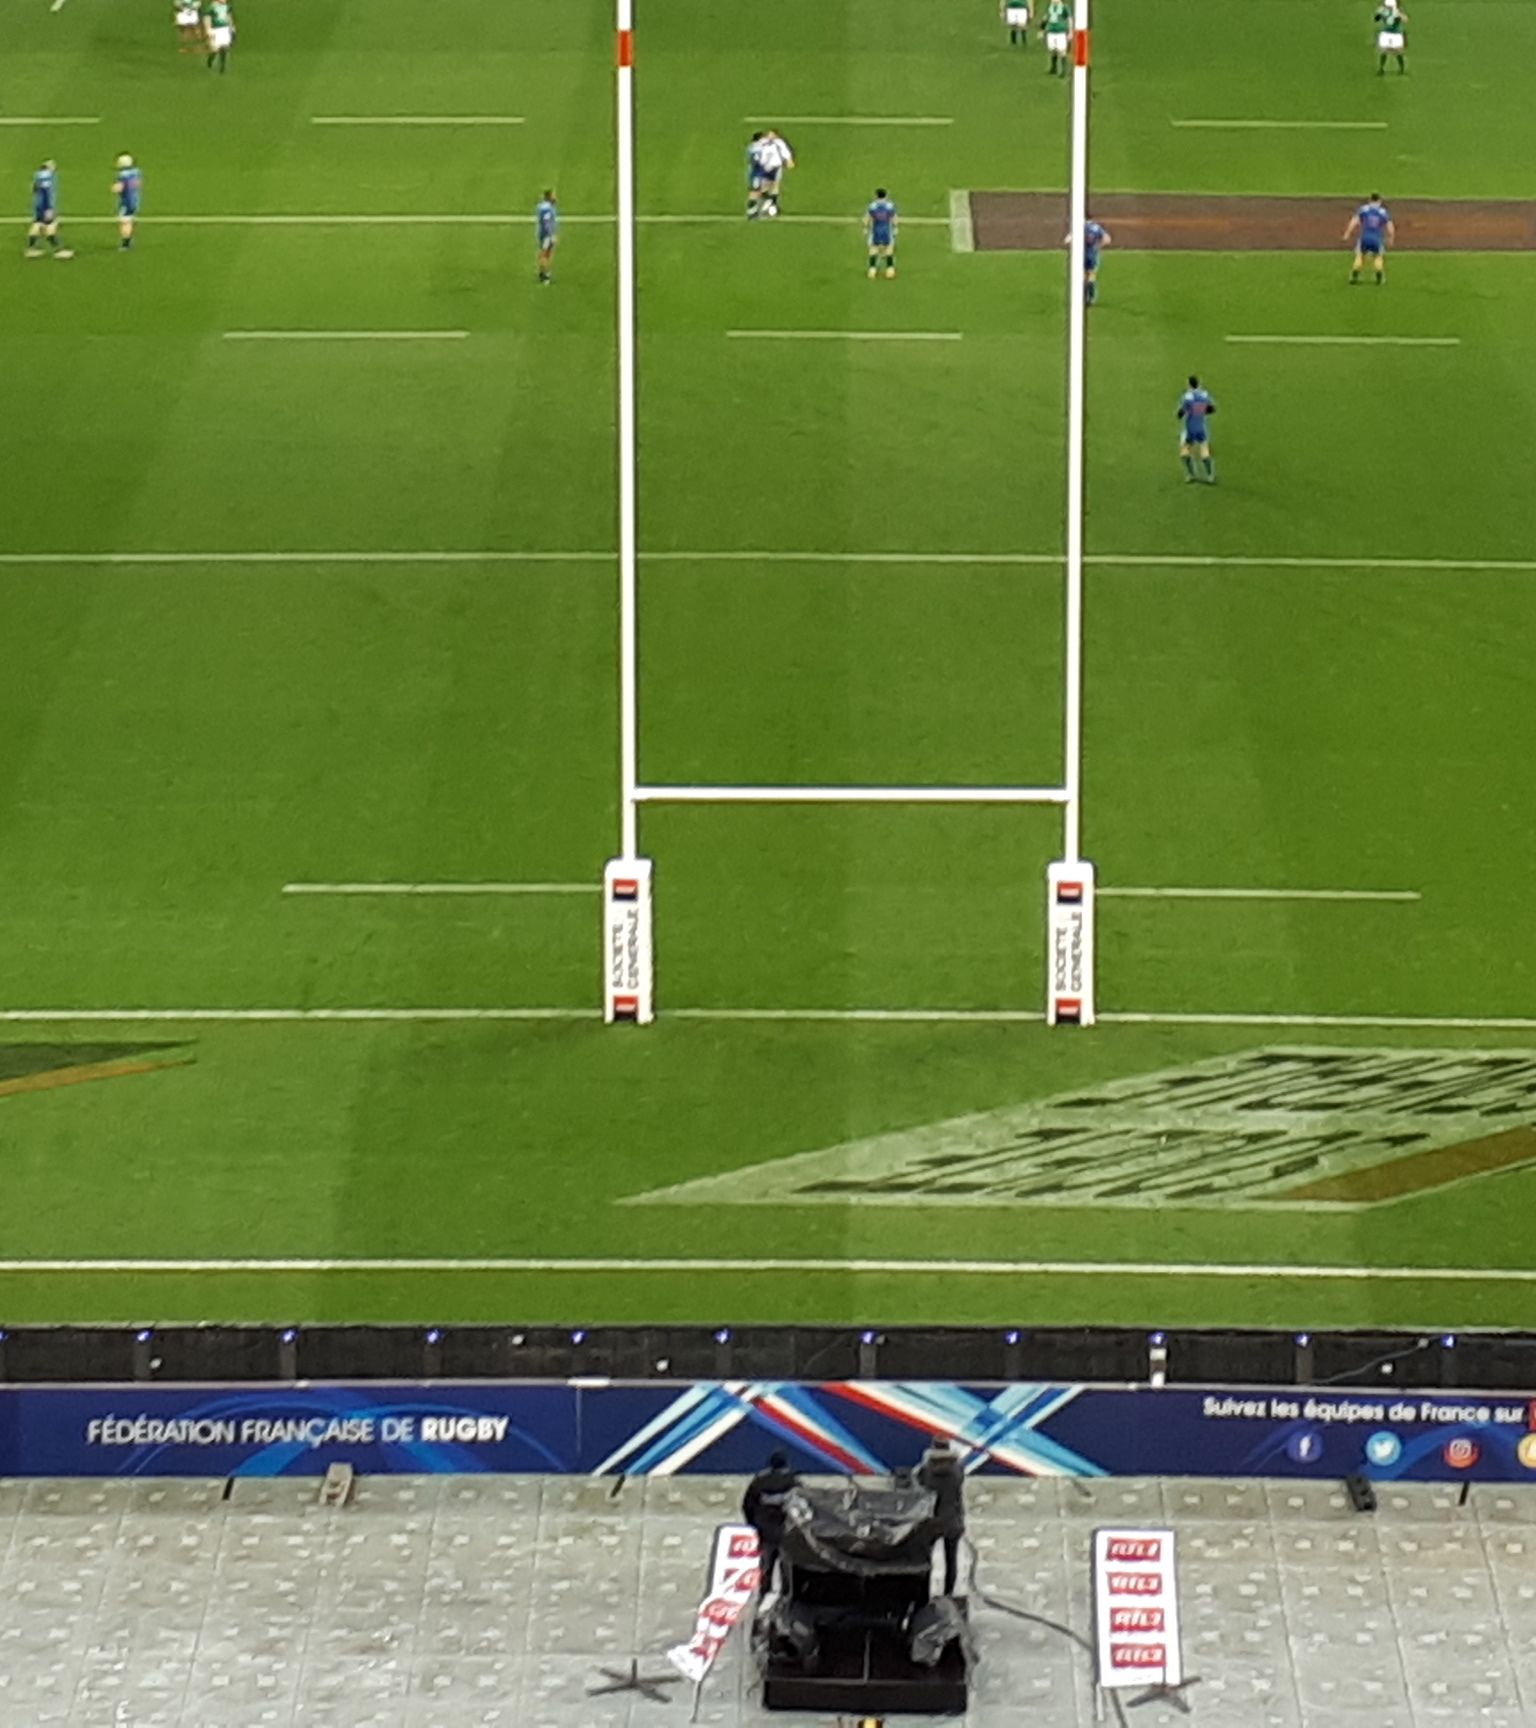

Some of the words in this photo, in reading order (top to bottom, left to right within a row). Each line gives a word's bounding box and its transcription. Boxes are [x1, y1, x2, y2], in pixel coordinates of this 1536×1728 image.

[1202, 1396, 1267, 1419] Suivez
[1270, 1397, 1300, 1420] les
[1303, 1398, 1385, 1425] équipes
[1388, 1398, 1417, 1422] de
[1420, 1401, 1491, 1424] France
[1493, 1406, 1524, 1424] sur
[86, 1411, 235, 1445] FÉDÉRATION
[240, 1415, 375, 1449] FRANÇAISE
[380, 1417, 414, 1443] DE
[420, 1416, 511, 1443] RUGBY
